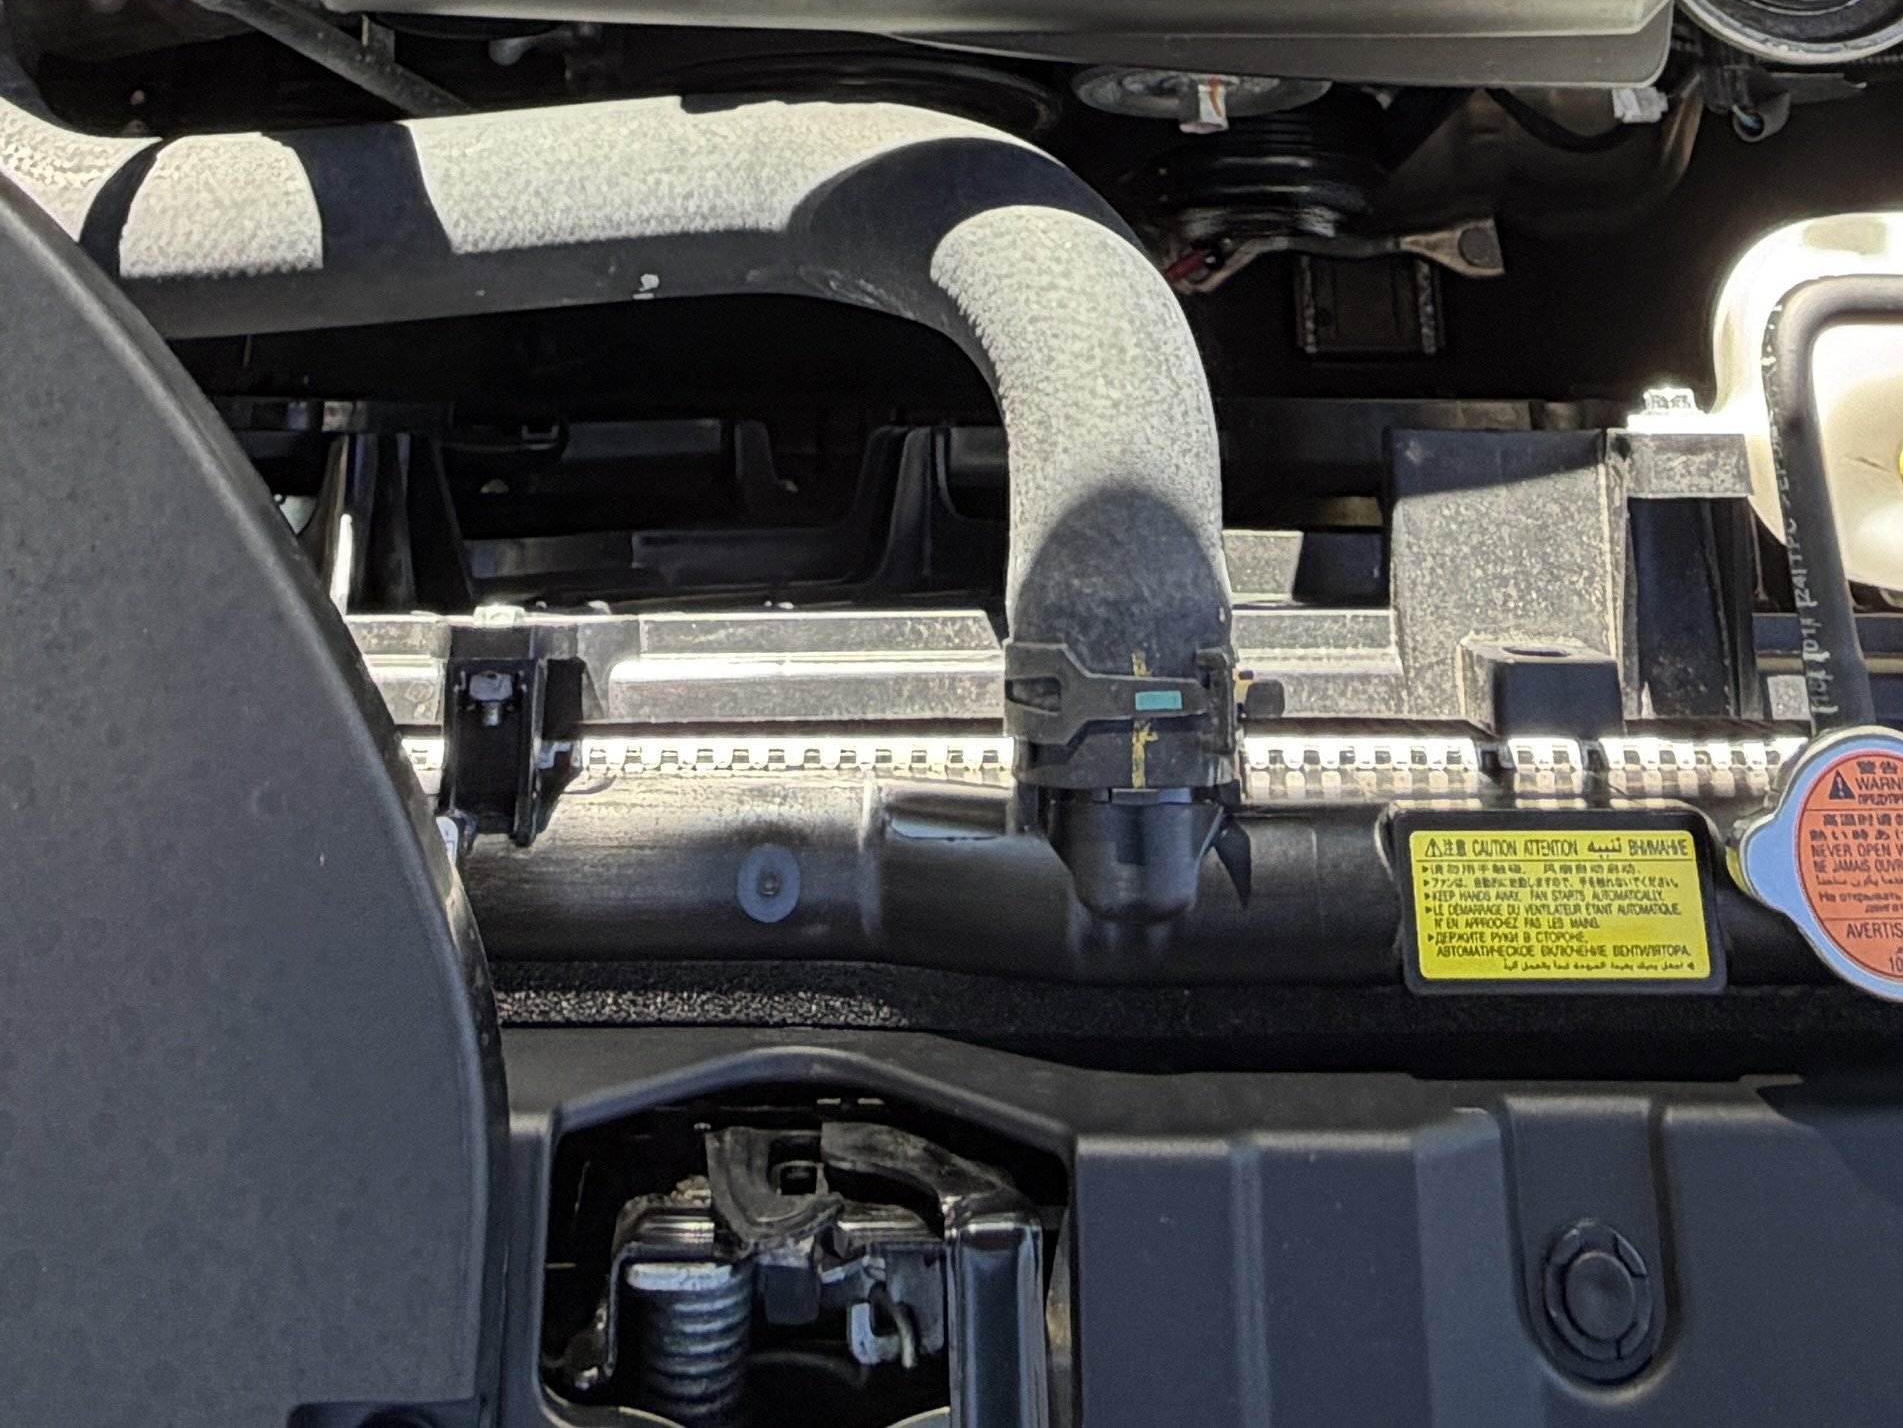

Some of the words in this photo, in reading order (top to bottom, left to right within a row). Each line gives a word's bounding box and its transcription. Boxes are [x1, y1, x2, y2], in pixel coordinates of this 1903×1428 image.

[1472, 839, 1518, 857] CAUTION
[1523, 839, 1579, 857] ATTENTION
[1628, 839, 1689, 856] ВНИМАНИЕ
[1812, 844, 1853, 858] NEVER
[1857, 844, 1892, 858] OPEN
[1813, 859, 1827, 873] NE
[1832, 859, 1871, 873] JAMAIS
[1432, 890, 1456, 902] KEEP
[1459, 890, 1491, 902] HANDS
[1529, 890, 1549, 902] FAN
[1552, 889, 1586, 902] STARTS
[1434, 904, 1446, 916] LE
[1507, 904, 1521, 916] DU
[1547, 918, 1565, 929] LES
